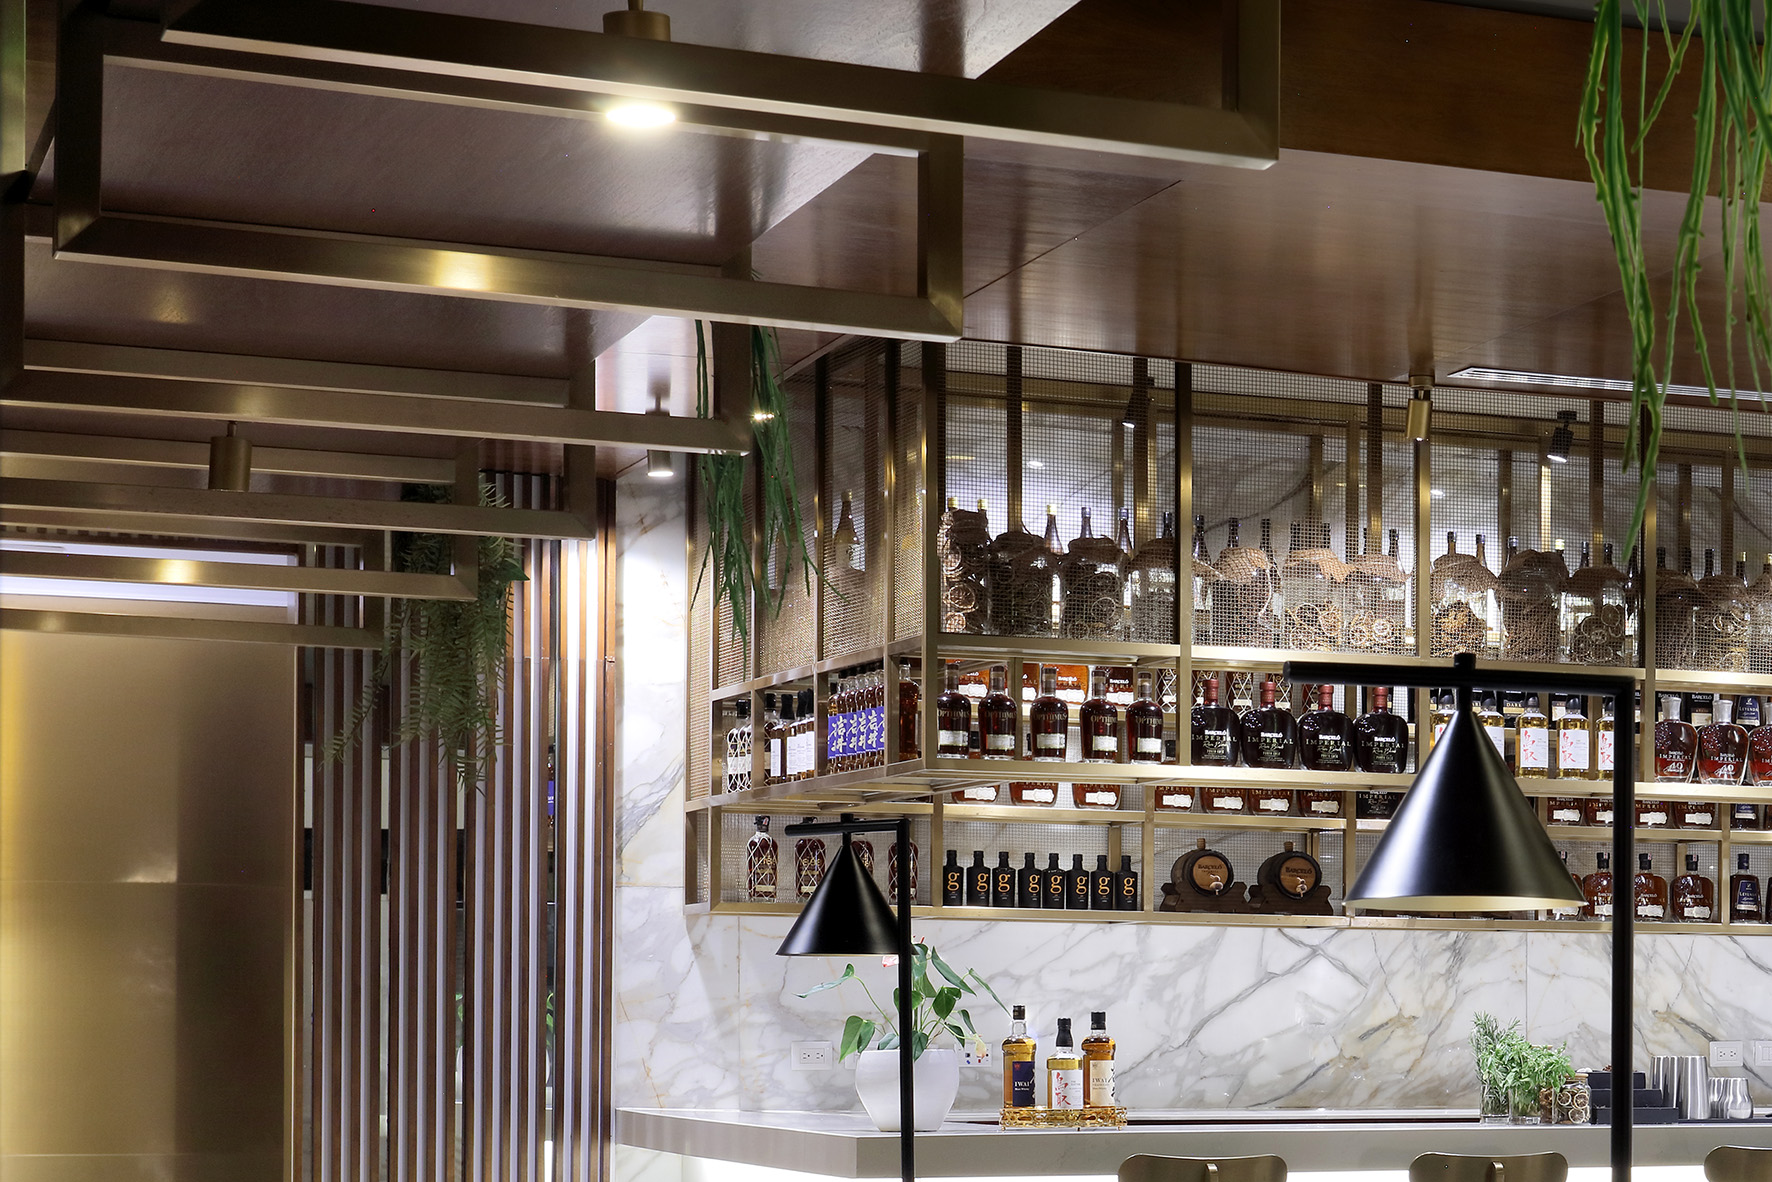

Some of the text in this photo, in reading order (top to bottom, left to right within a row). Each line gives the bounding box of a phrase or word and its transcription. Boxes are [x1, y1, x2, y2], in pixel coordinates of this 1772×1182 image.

[1192, 734, 1238, 743] IMPERIAL
[1247, 736, 1294, 745] IMPERIAL
[1305, 739, 1352, 747] IMPERIAL
[1361, 740, 1405, 749] IMPERIAL
[1671, 762, 1684, 770] 40
[1710, 755, 1744, 763] IMPERIAL
[1722, 764, 1735, 772] 40
[947, 871, 960, 891] g
[976, 872, 989, 892] g
[998, 873, 1011, 893] g
[1028, 874, 1040, 894] g
[1049, 874, 1062, 894] g
[1076, 875, 1088, 895] g
[1098, 876, 1111, 895] g
[1123, 876, 1135, 896] g
